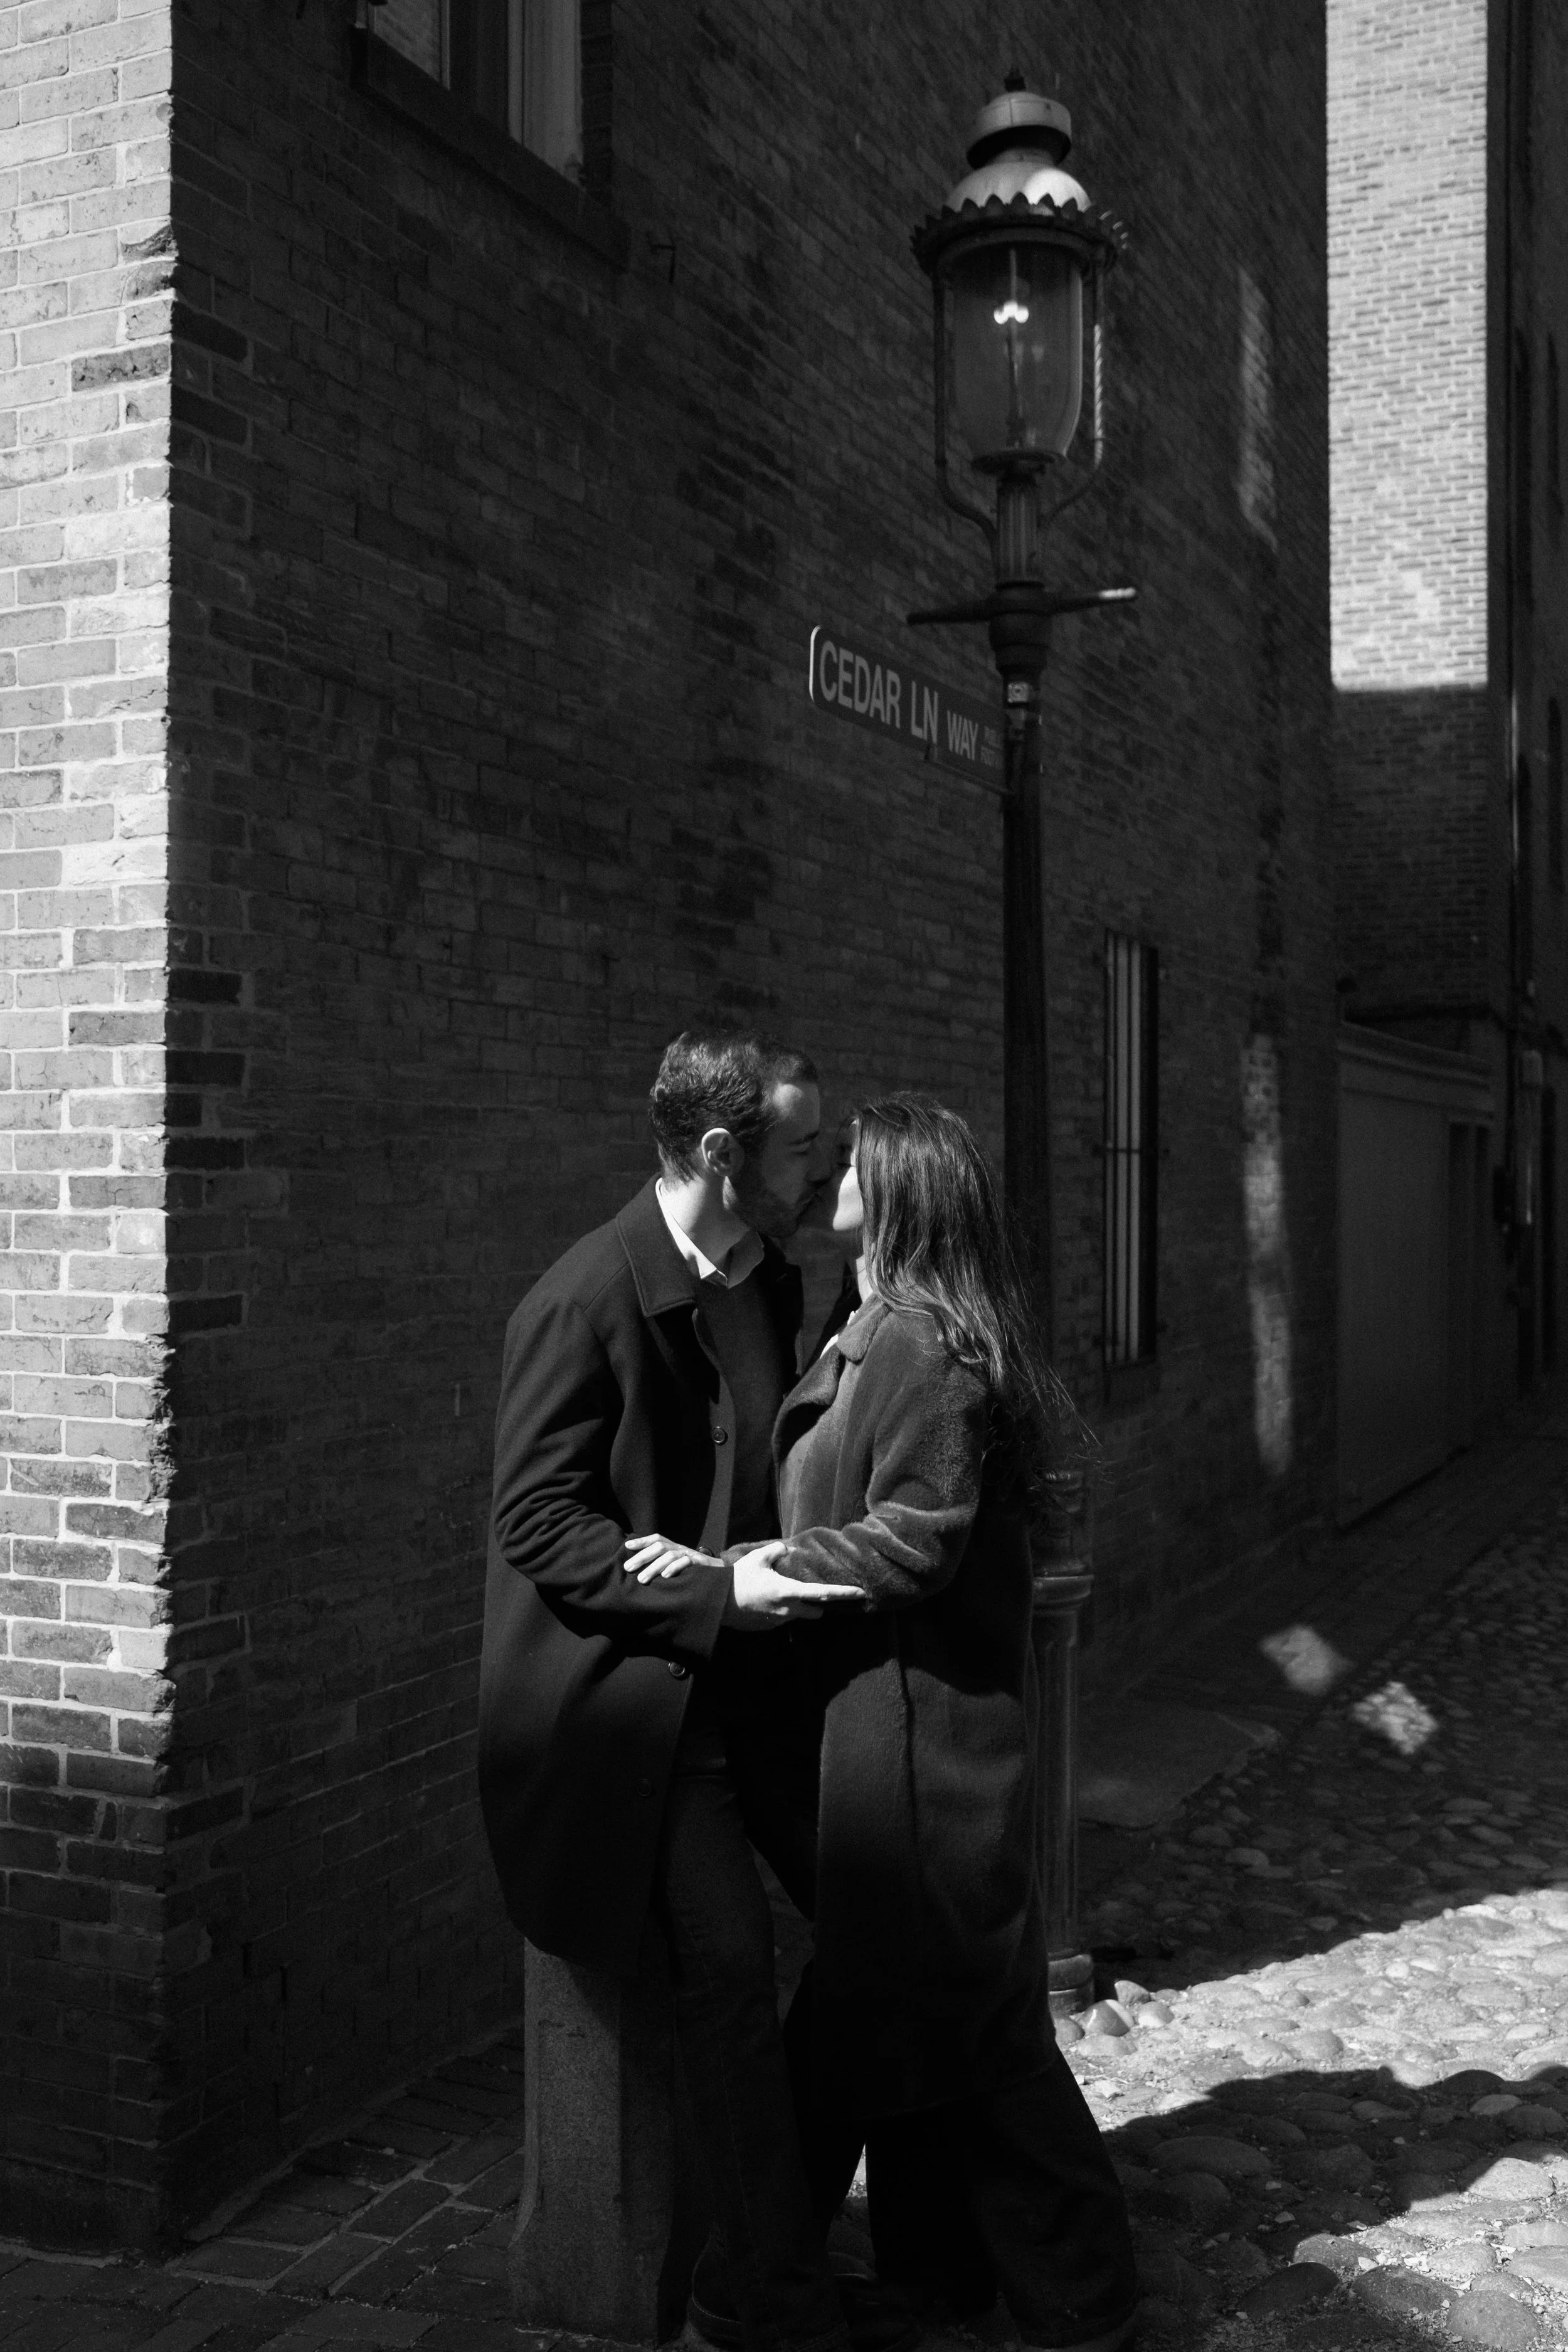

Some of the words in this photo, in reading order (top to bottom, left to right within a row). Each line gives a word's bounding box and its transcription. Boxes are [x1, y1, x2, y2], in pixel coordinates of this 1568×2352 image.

[818, 640, 902, 729] CEDAR
[910, 680, 939, 745] LN
[946, 709, 979, 761] WAY
